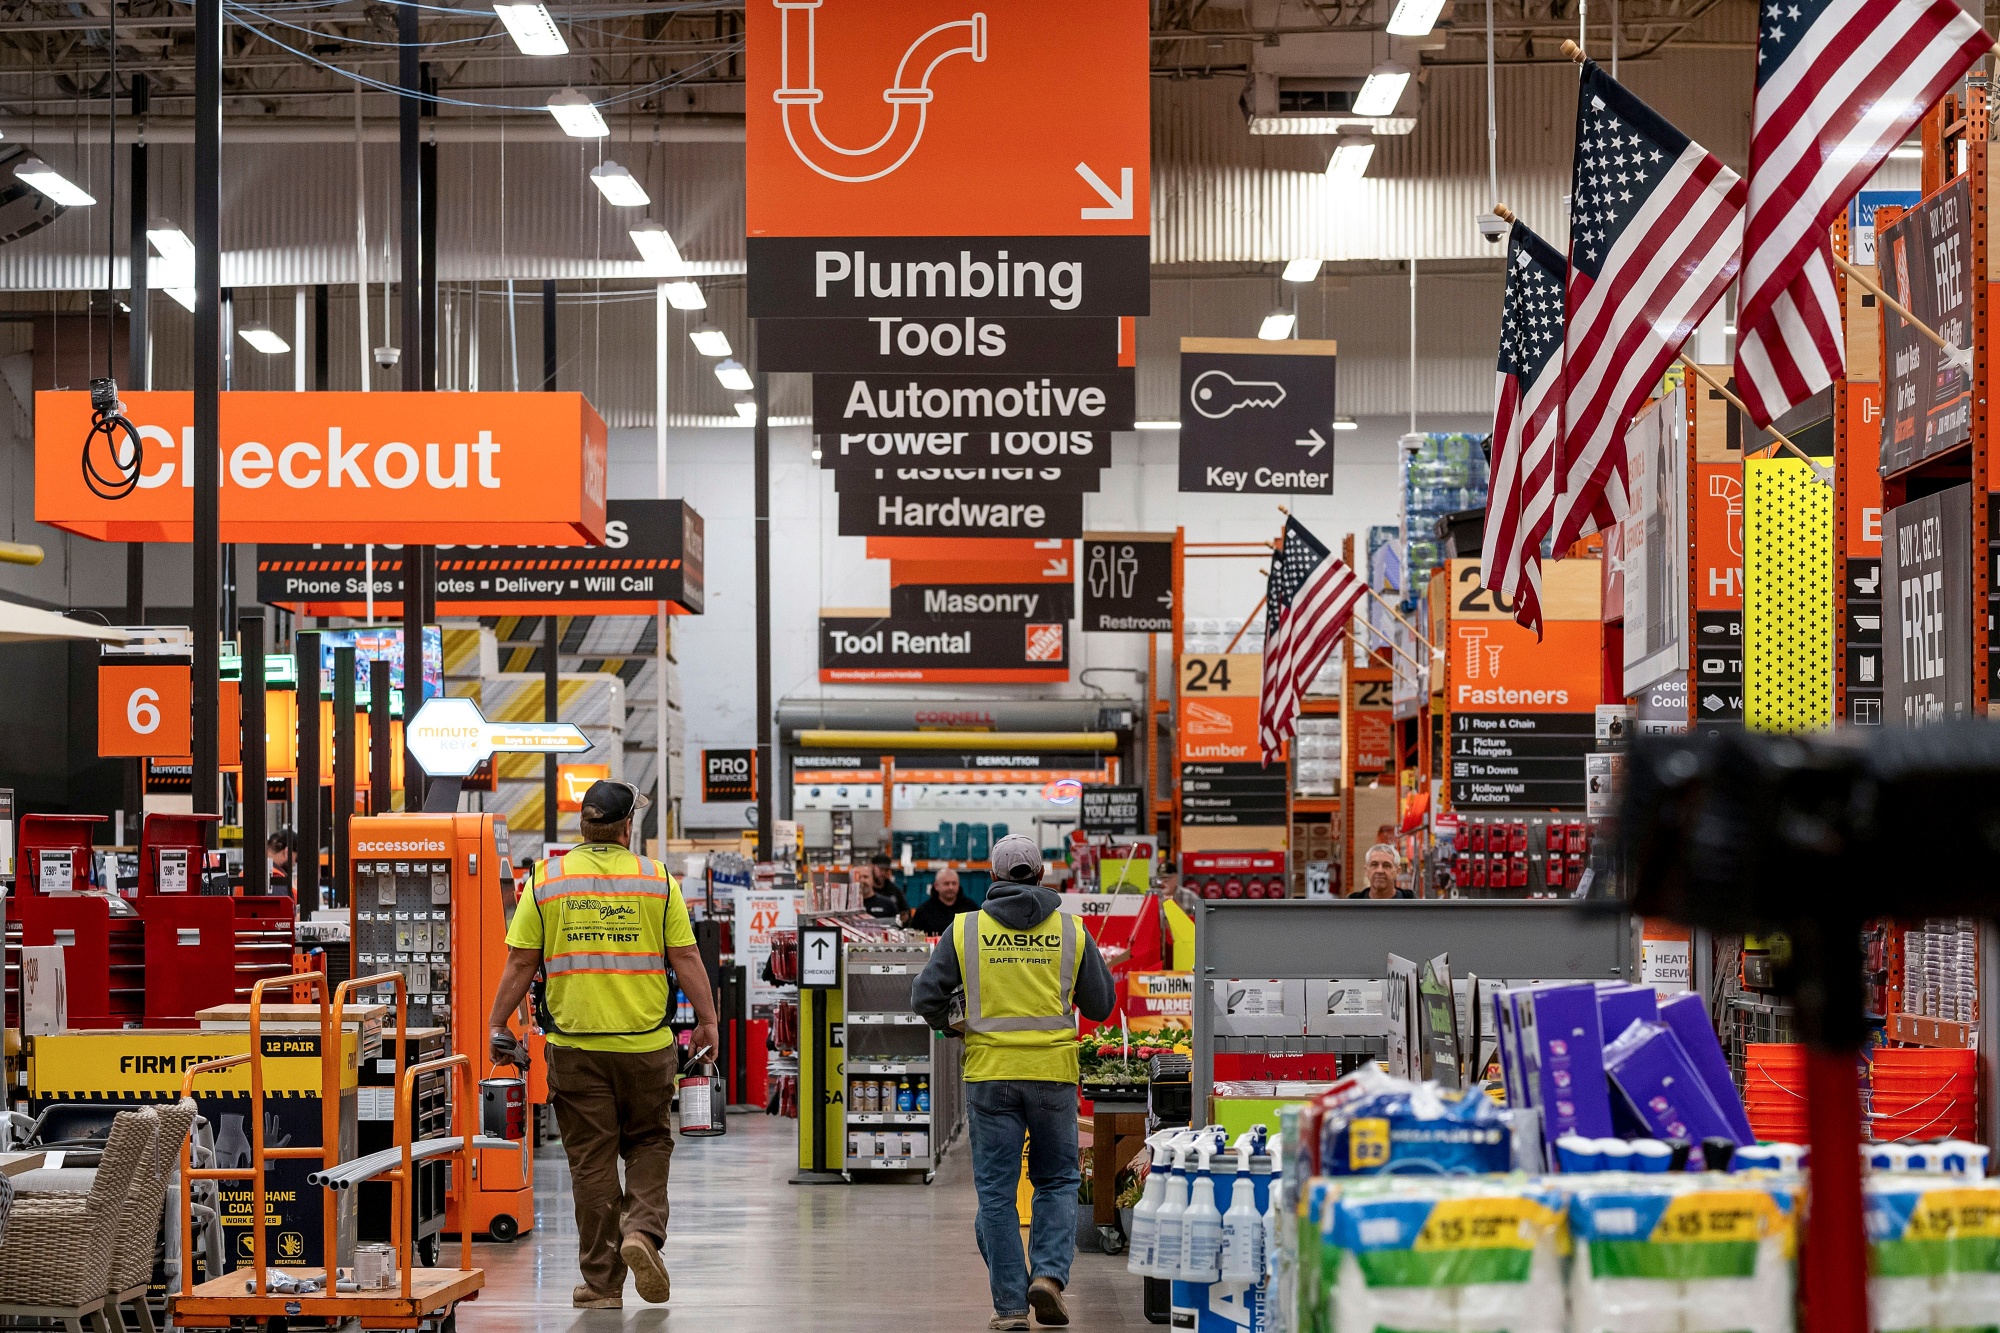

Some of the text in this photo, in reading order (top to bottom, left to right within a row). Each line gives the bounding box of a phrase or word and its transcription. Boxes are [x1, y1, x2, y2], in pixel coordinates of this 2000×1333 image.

[816, 251, 1082, 310] Plumbing
[1934, 232, 1963, 317] FREE
[869, 317, 1006, 356] Tools
[843, 379, 1106, 418] Automotive
[840, 432, 968, 455] Power
[1207, 467, 1329, 491] Key Center
[878, 496, 1045, 527] Hardware
[1900, 525, 1912, 567] BUY
[1922, 518, 1934, 563] GET
[1936, 516, 1941, 556] 2
[286, 578, 340, 593] Phone
[346, 578, 392, 593] Saes
[495, 577, 564, 596] Delivery
[584, 578, 617, 592] Will
[621, 577, 653, 592] Call
[924, 590, 1038, 618] Masonry
[1902, 570, 1944, 683] FREE
[830, 632, 883, 654] Tool
[892, 631, 970, 654] Rental
[1186, 659, 1231, 691] 24
[1458, 685, 1568, 704] Fasteners
[126, 687, 161, 734] 6
[1473, 719, 1535, 730] Rope & Chain
[1646, 726, 1667, 735] LET
[418, 727, 478, 737] minute
[504, 737, 524, 746] keys
[540, 736, 568, 744] minute
[1474, 738, 1506, 747] Picture
[1186, 743, 1247, 757] Lumber
[1474, 747, 1512, 758] Hangers
[709, 758, 748, 774] PRO
[976, 756, 1040, 767] DEMOLITION
[1471, 766, 1518, 775] Tie Downs
[709, 774, 748, 782] SERVICES
[1472, 784, 1524, 793] Hollow Wall
[1084, 793, 1138, 804] RENT WHAT
[1472, 794, 1510, 802] Anchors
[1084, 804, 1138, 817] YOU NEED
[358, 838, 445, 852] accessories
[600, 906, 636, 920] Electric
[752, 902, 778, 910] PERKS
[567, 932, 640, 942] SAFETY FIRST
[266, 1042, 314, 1052] 12 PAIR
[120, 1056, 176, 1073] FIRM
[218, 1192, 296, 1202] OLYURHANE
[228, 1204, 274, 1214] COAD
